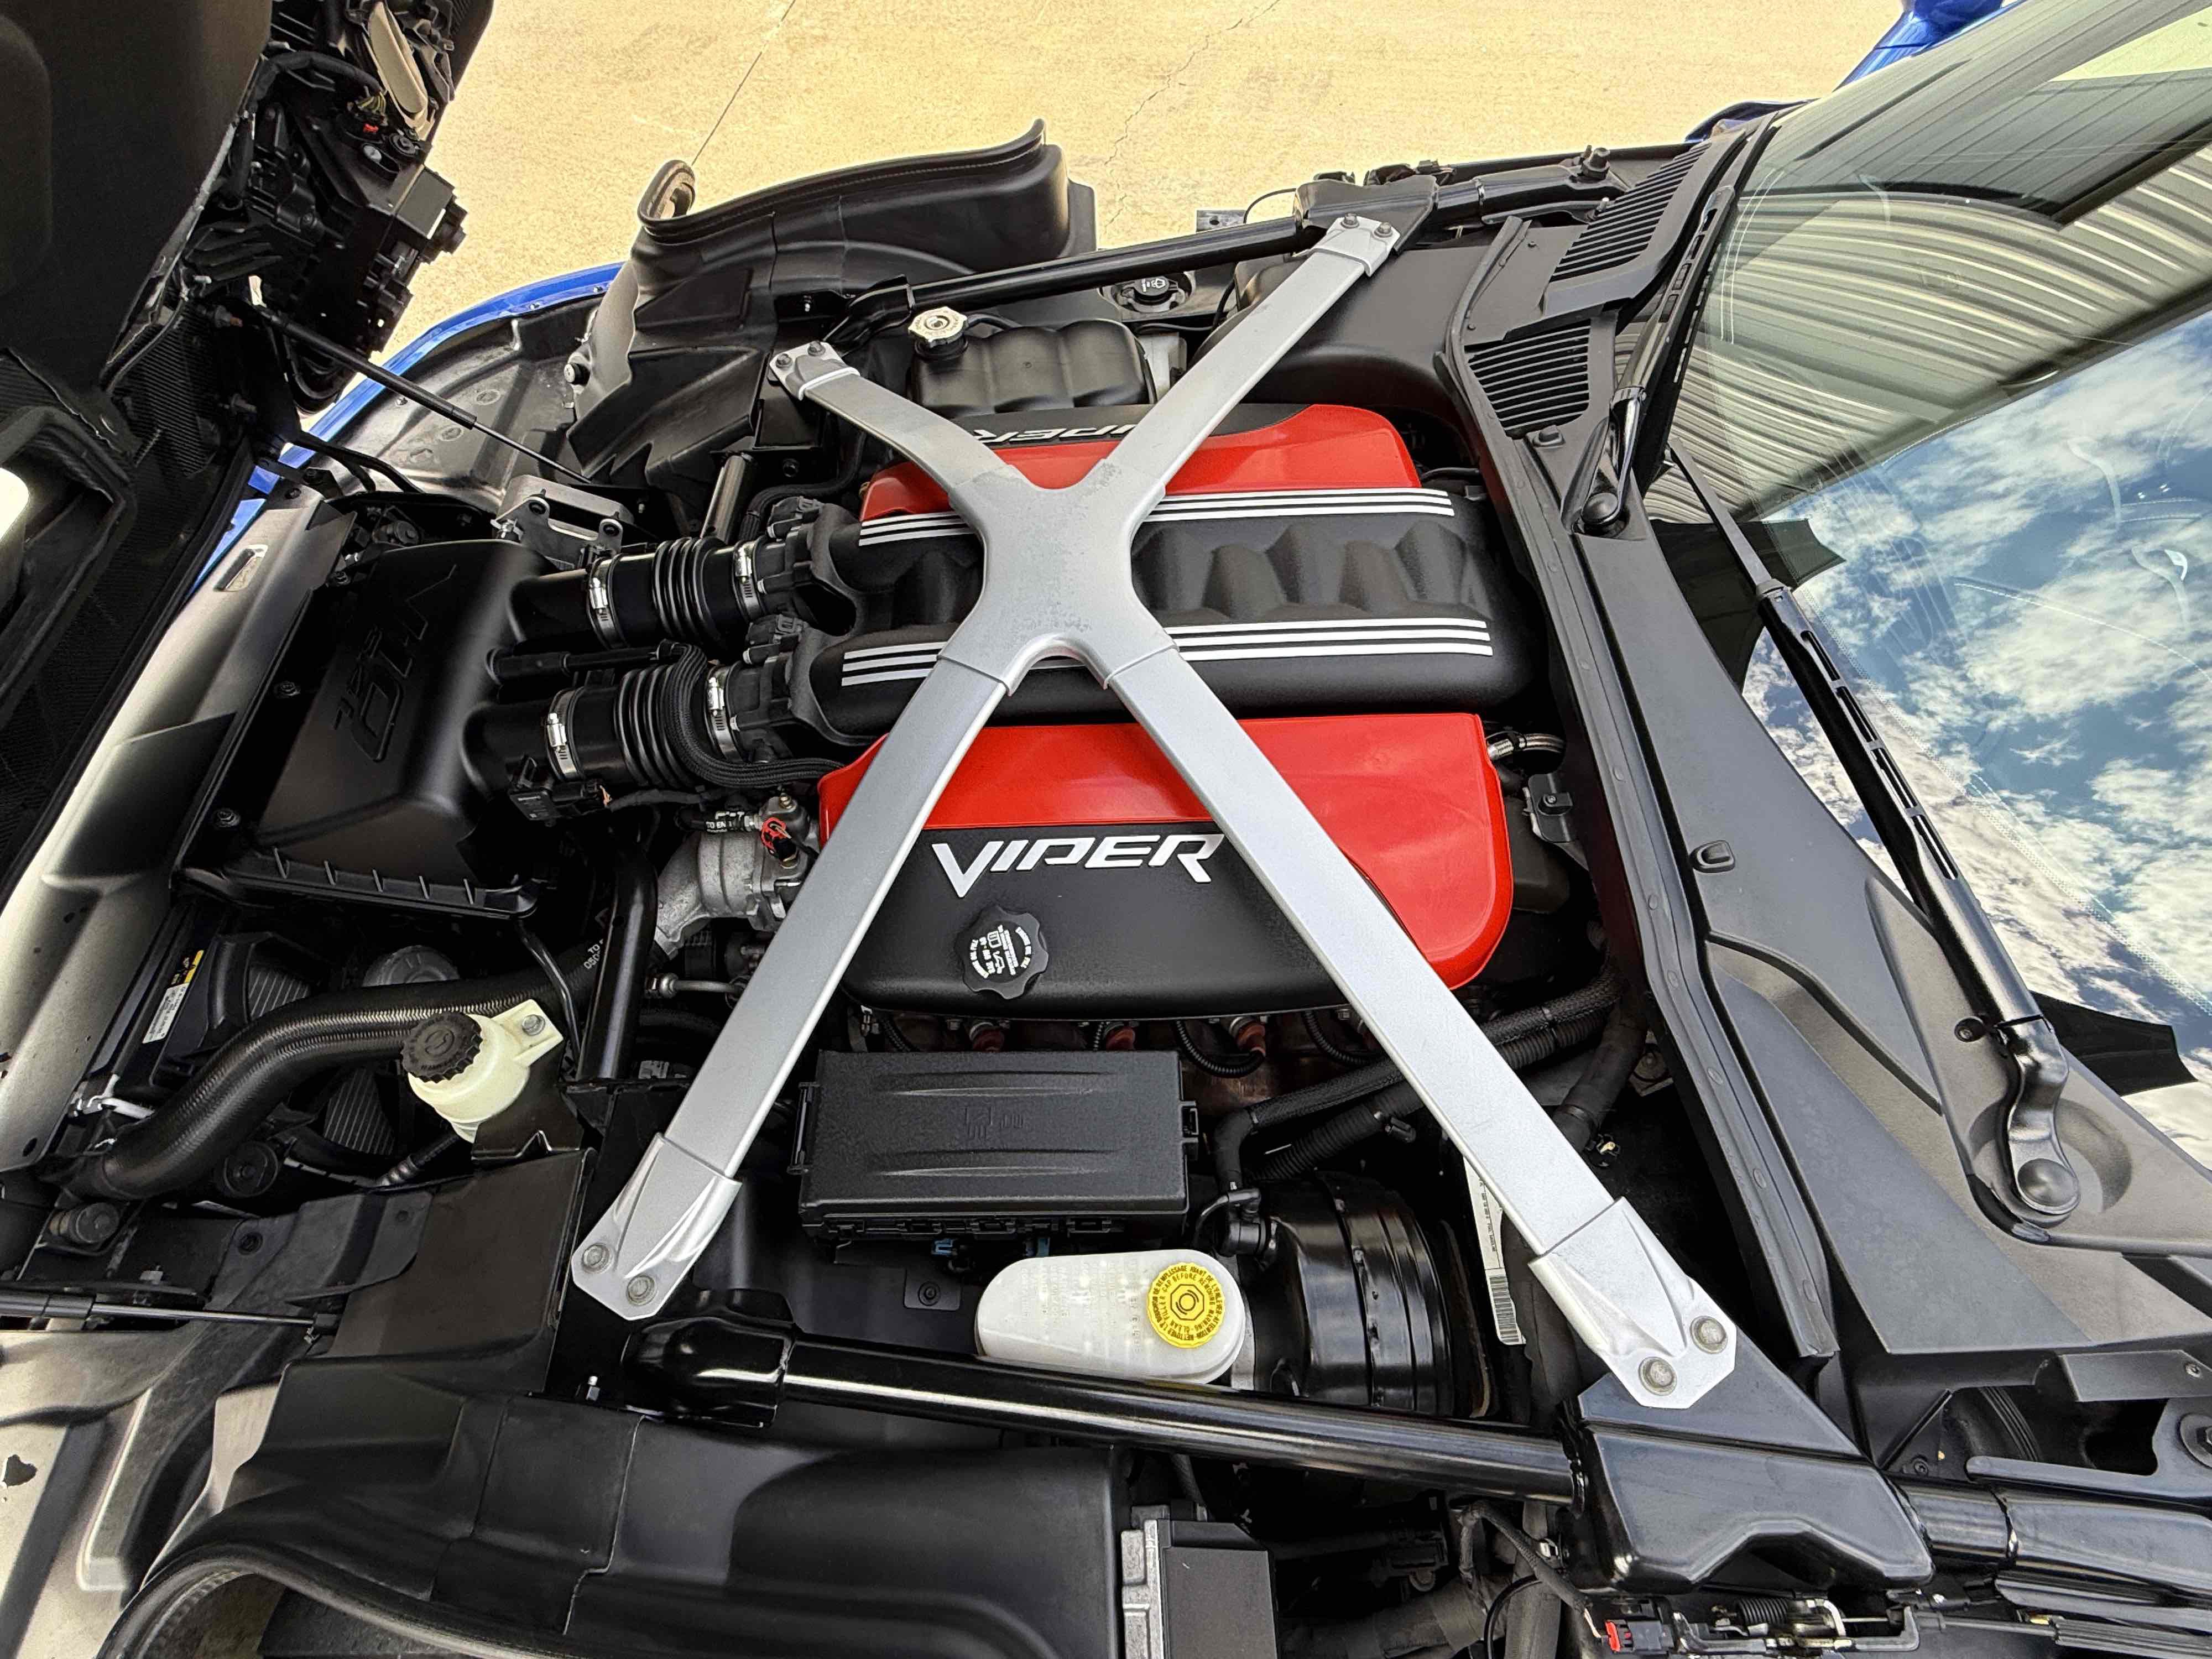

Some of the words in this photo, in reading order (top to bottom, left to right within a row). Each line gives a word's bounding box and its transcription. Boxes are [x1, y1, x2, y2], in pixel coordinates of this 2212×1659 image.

[974, 424, 1138, 444] IPER
[932, 833, 1224, 898] VIPER
[1162, 1280, 1172, 1292] CAP
[1172, 1273, 1197, 1282] BEFORE
